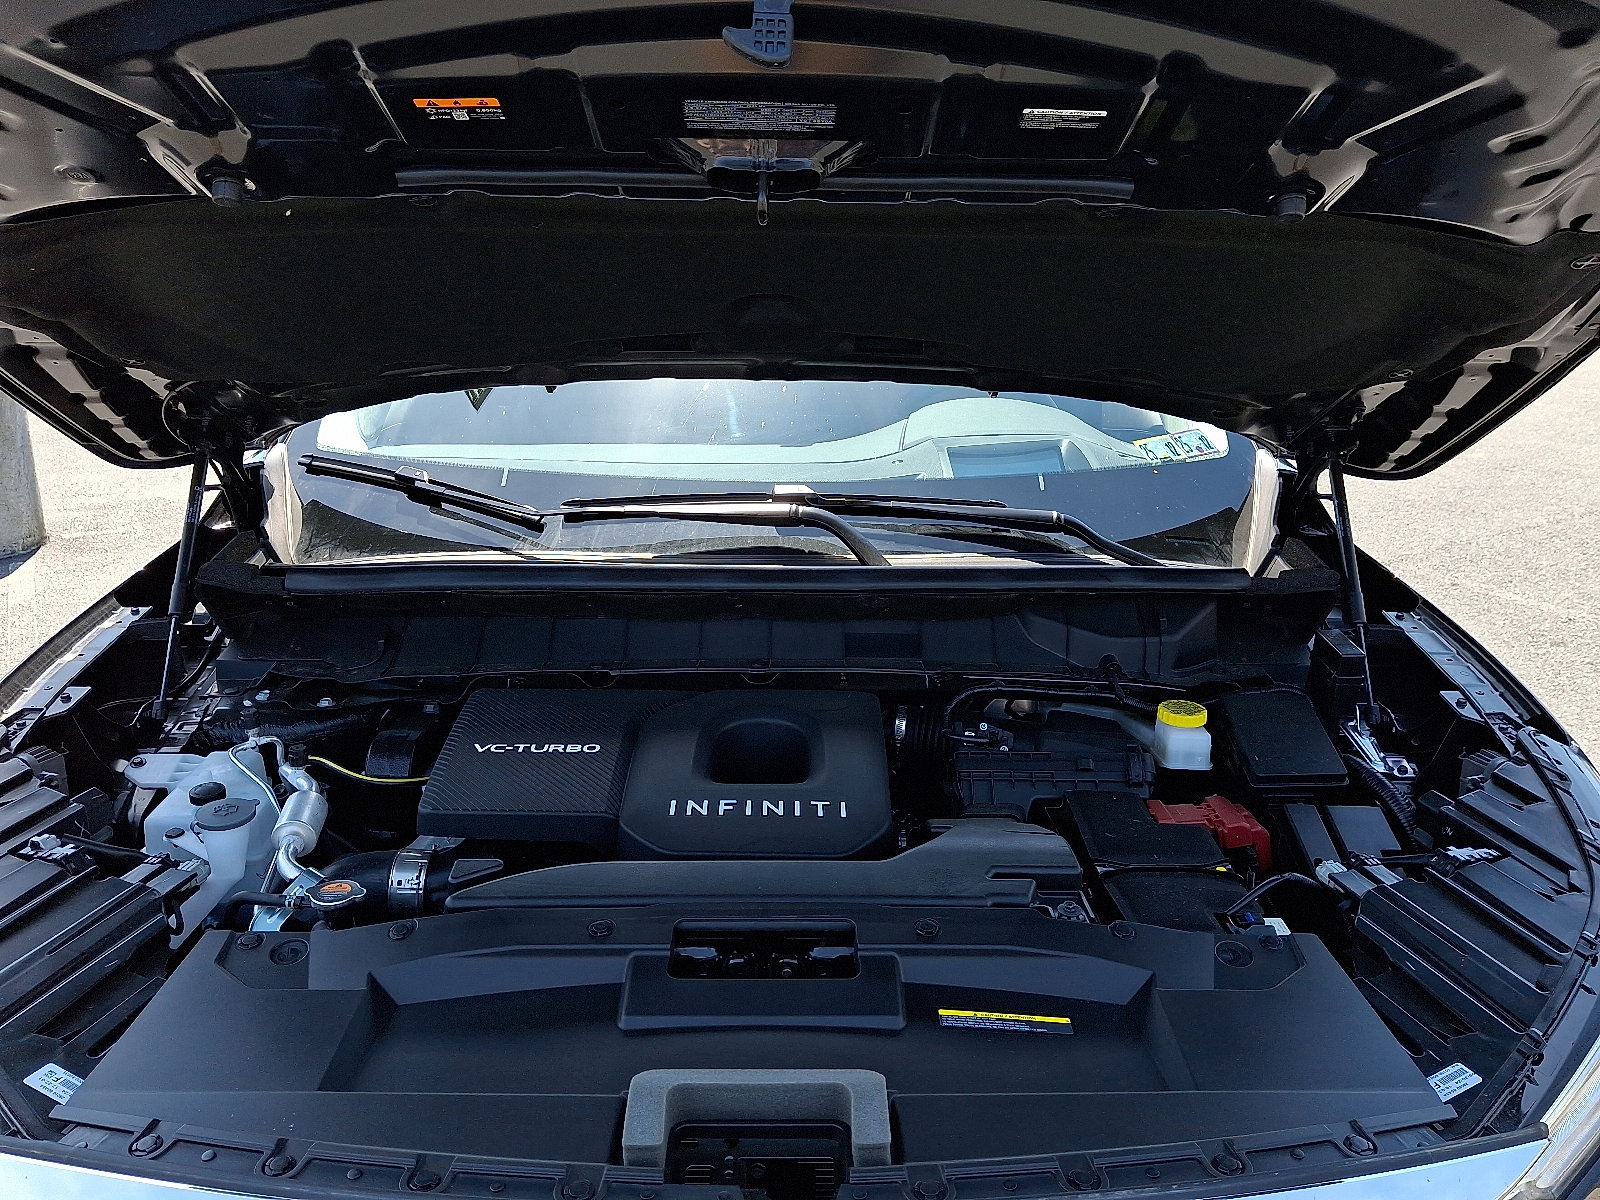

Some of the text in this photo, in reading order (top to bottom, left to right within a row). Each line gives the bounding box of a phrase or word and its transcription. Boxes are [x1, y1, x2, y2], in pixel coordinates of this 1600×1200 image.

[1165, 441, 1181, 457] 12
[1198, 434, 1214, 450] 12
[474, 743, 601, 753] VC-TURBO
[668, 799, 848, 818] INFINITI
